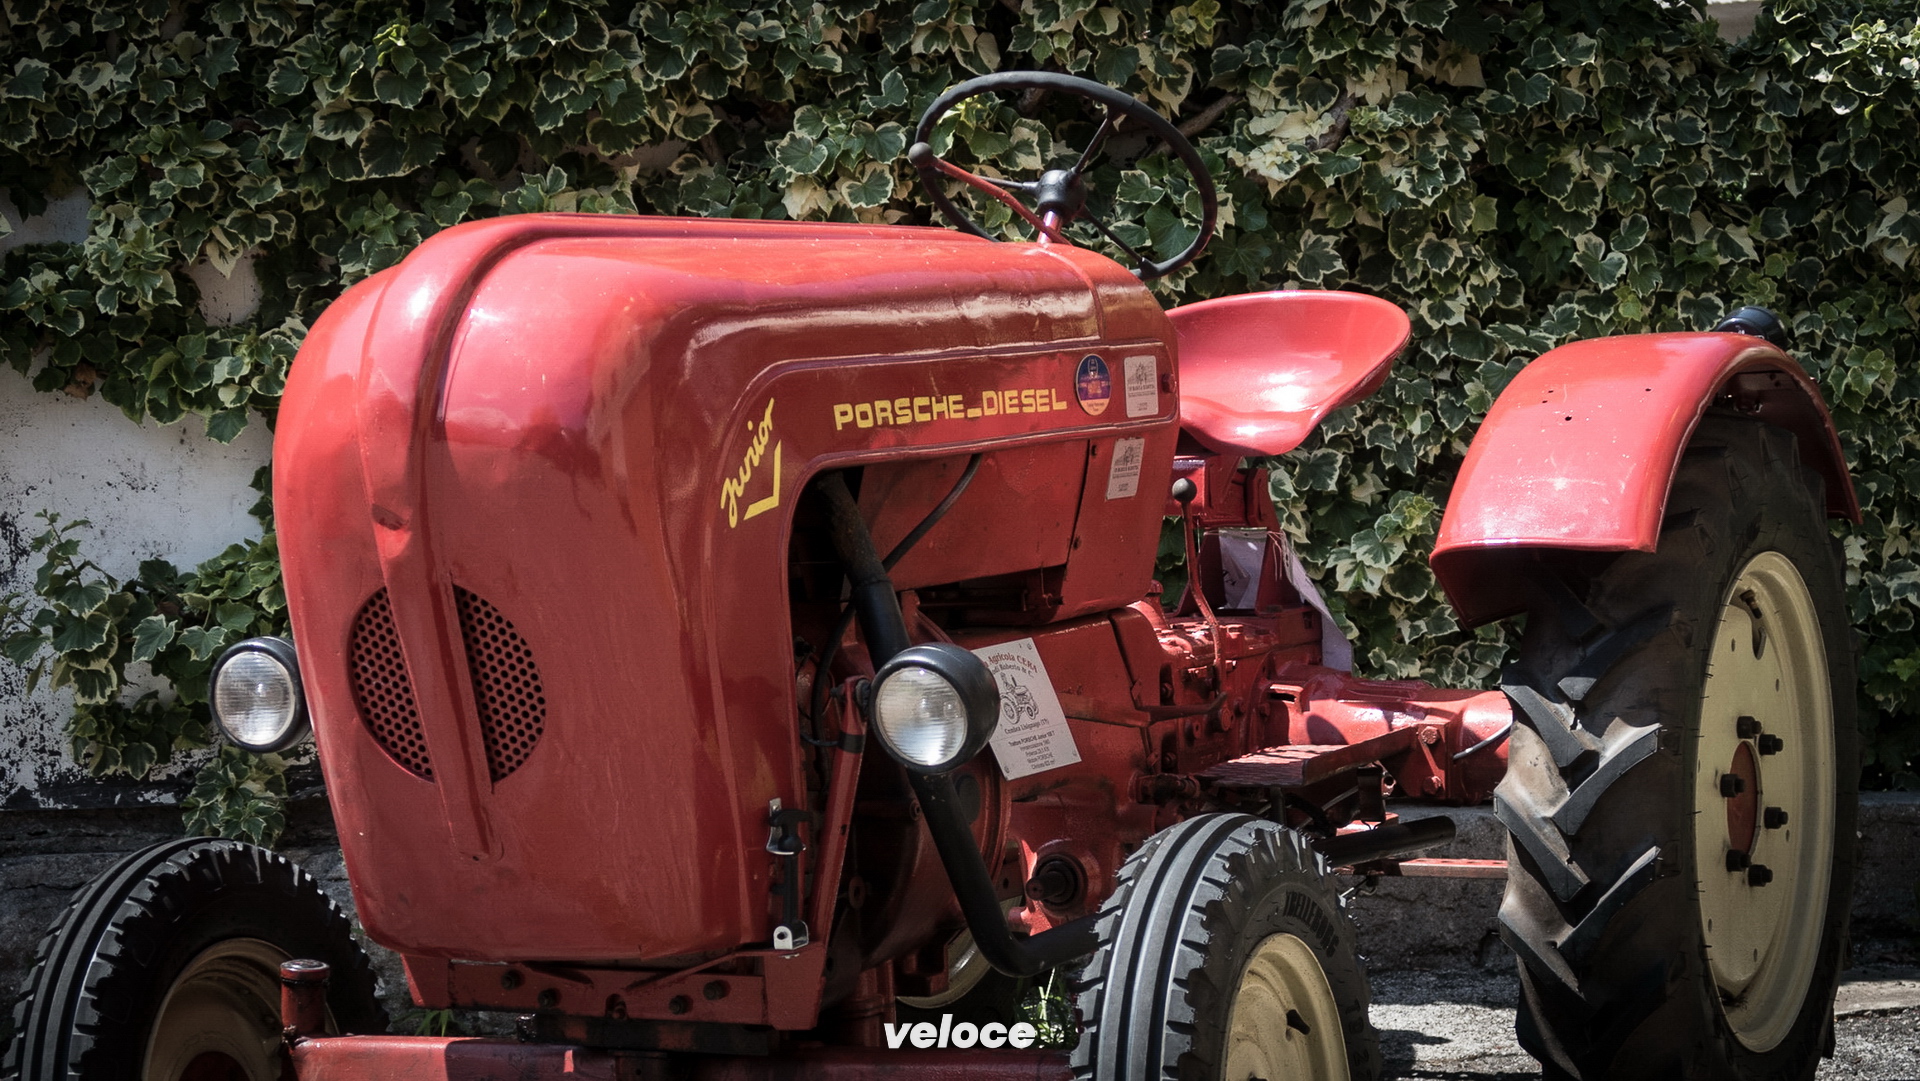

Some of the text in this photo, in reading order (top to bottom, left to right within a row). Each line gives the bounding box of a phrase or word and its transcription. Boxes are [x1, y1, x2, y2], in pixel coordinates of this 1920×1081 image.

[720, 397, 775, 529] Junior
[988, 652, 1015, 665] Agricola
[1021, 735, 1037, 744] PORSCHE
